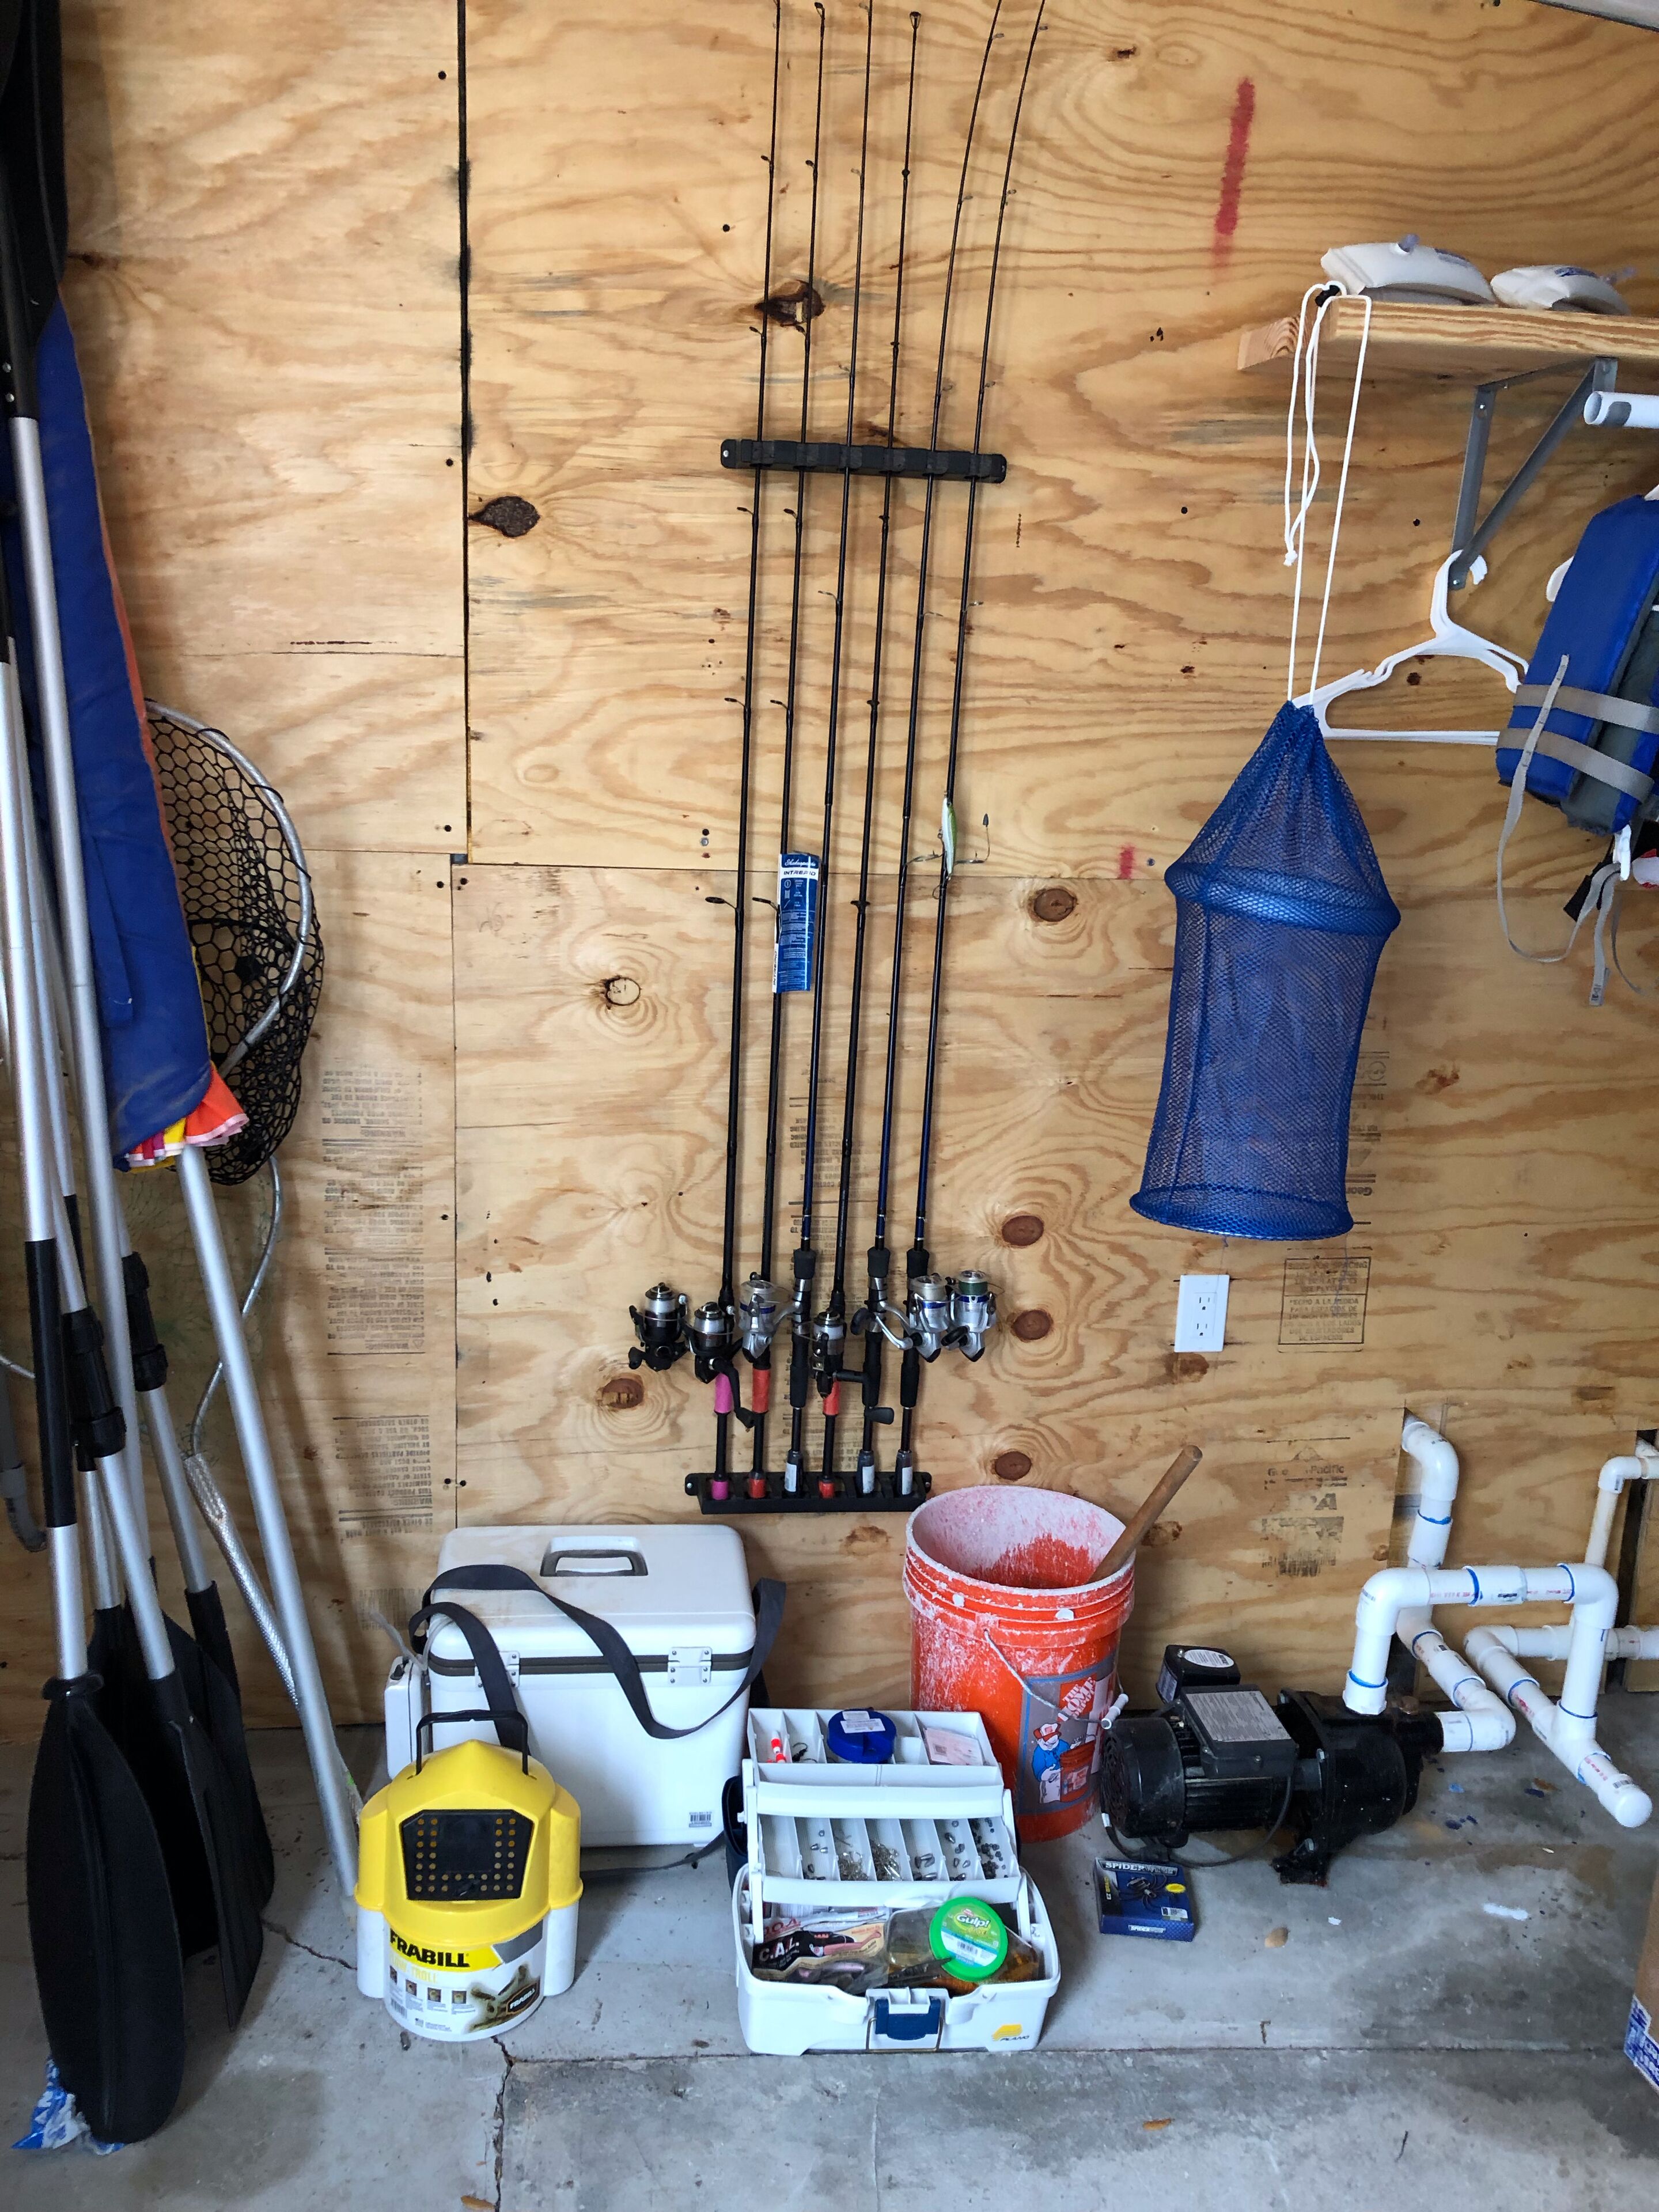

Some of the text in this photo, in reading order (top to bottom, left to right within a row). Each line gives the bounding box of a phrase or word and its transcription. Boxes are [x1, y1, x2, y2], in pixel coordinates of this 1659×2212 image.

[1058, 1676, 1096, 1721] HOME
[956, 1915, 991, 1927] Gulp!
[390, 1927, 470, 1967] FRABILL
